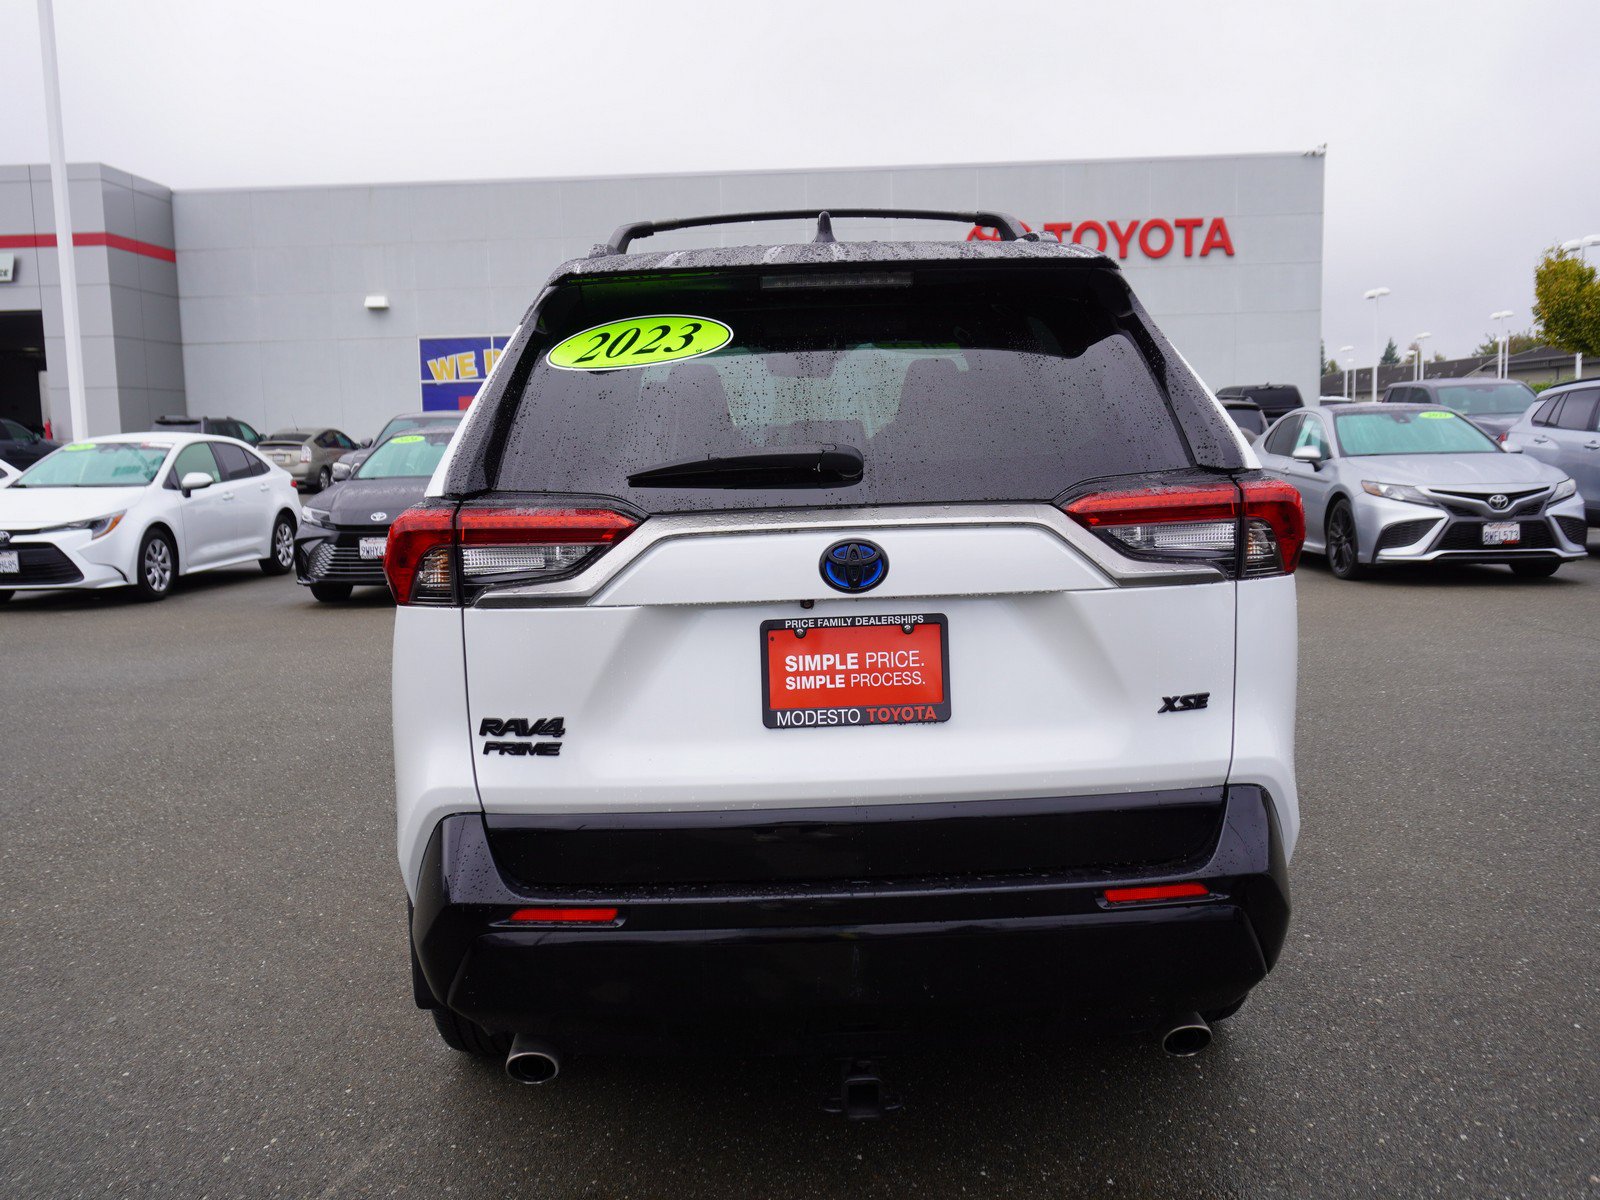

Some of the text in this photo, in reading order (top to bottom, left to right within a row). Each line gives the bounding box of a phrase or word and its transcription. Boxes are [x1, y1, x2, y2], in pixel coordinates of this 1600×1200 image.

[1044, 217, 1235, 259] TOYOTA
[571, 323, 703, 364] 2023
[427, 350, 478, 385] WE
[785, 615, 924, 629] PRICE FAMILY DEALERSHIPS
[785, 650, 925, 673] SIMPLE PRICE.
[785, 671, 926, 690] SIMPLE PROCESS.
[1157, 692, 1210, 713] XSE
[777, 706, 937, 726] MODESTO TOYOTA
[479, 717, 566, 738] RAV4
[483, 741, 562, 756] PRIME
